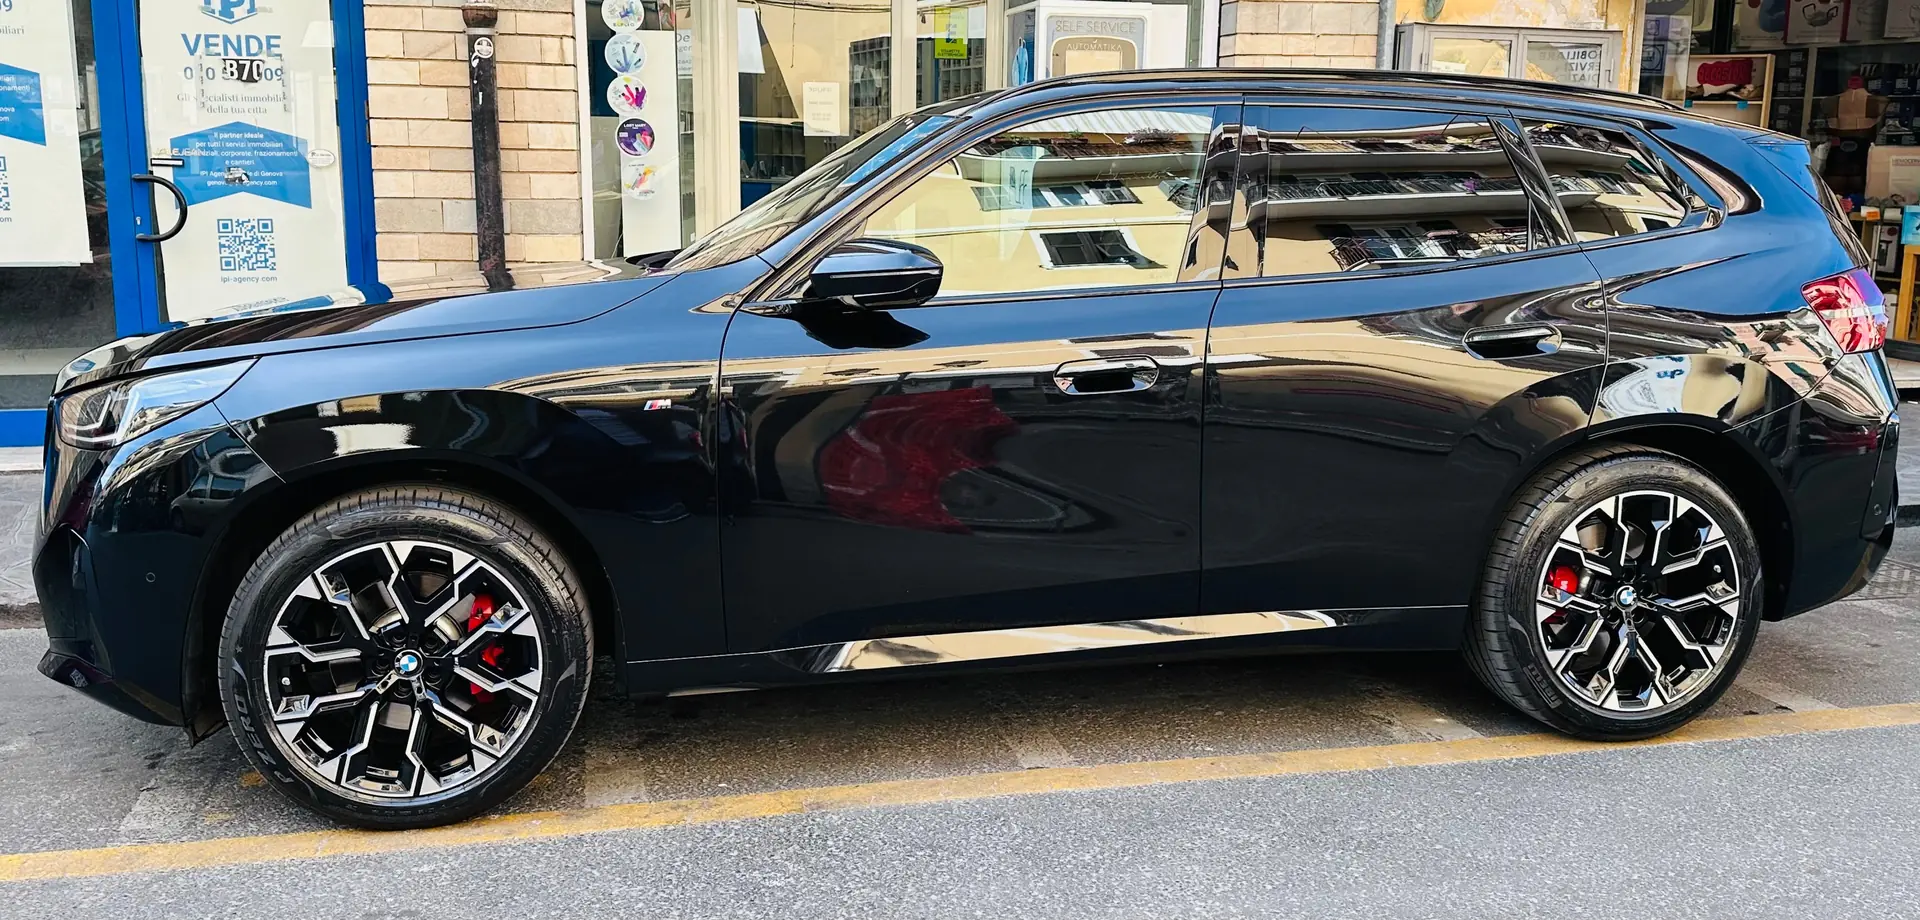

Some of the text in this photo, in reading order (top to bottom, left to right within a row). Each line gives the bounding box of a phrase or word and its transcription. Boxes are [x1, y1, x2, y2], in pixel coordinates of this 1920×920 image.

[1055, 20, 1136, 33] SELF SERVICE
[181, 33, 281, 57] VENDE
[1066, 43, 1122, 52] AUTOMATIKA
[206, 105, 229, 114] della
[231, 106, 246, 114] tua
[254, 149, 298, 157] frazionamenti
[232, 693, 276, 773] ZERO
